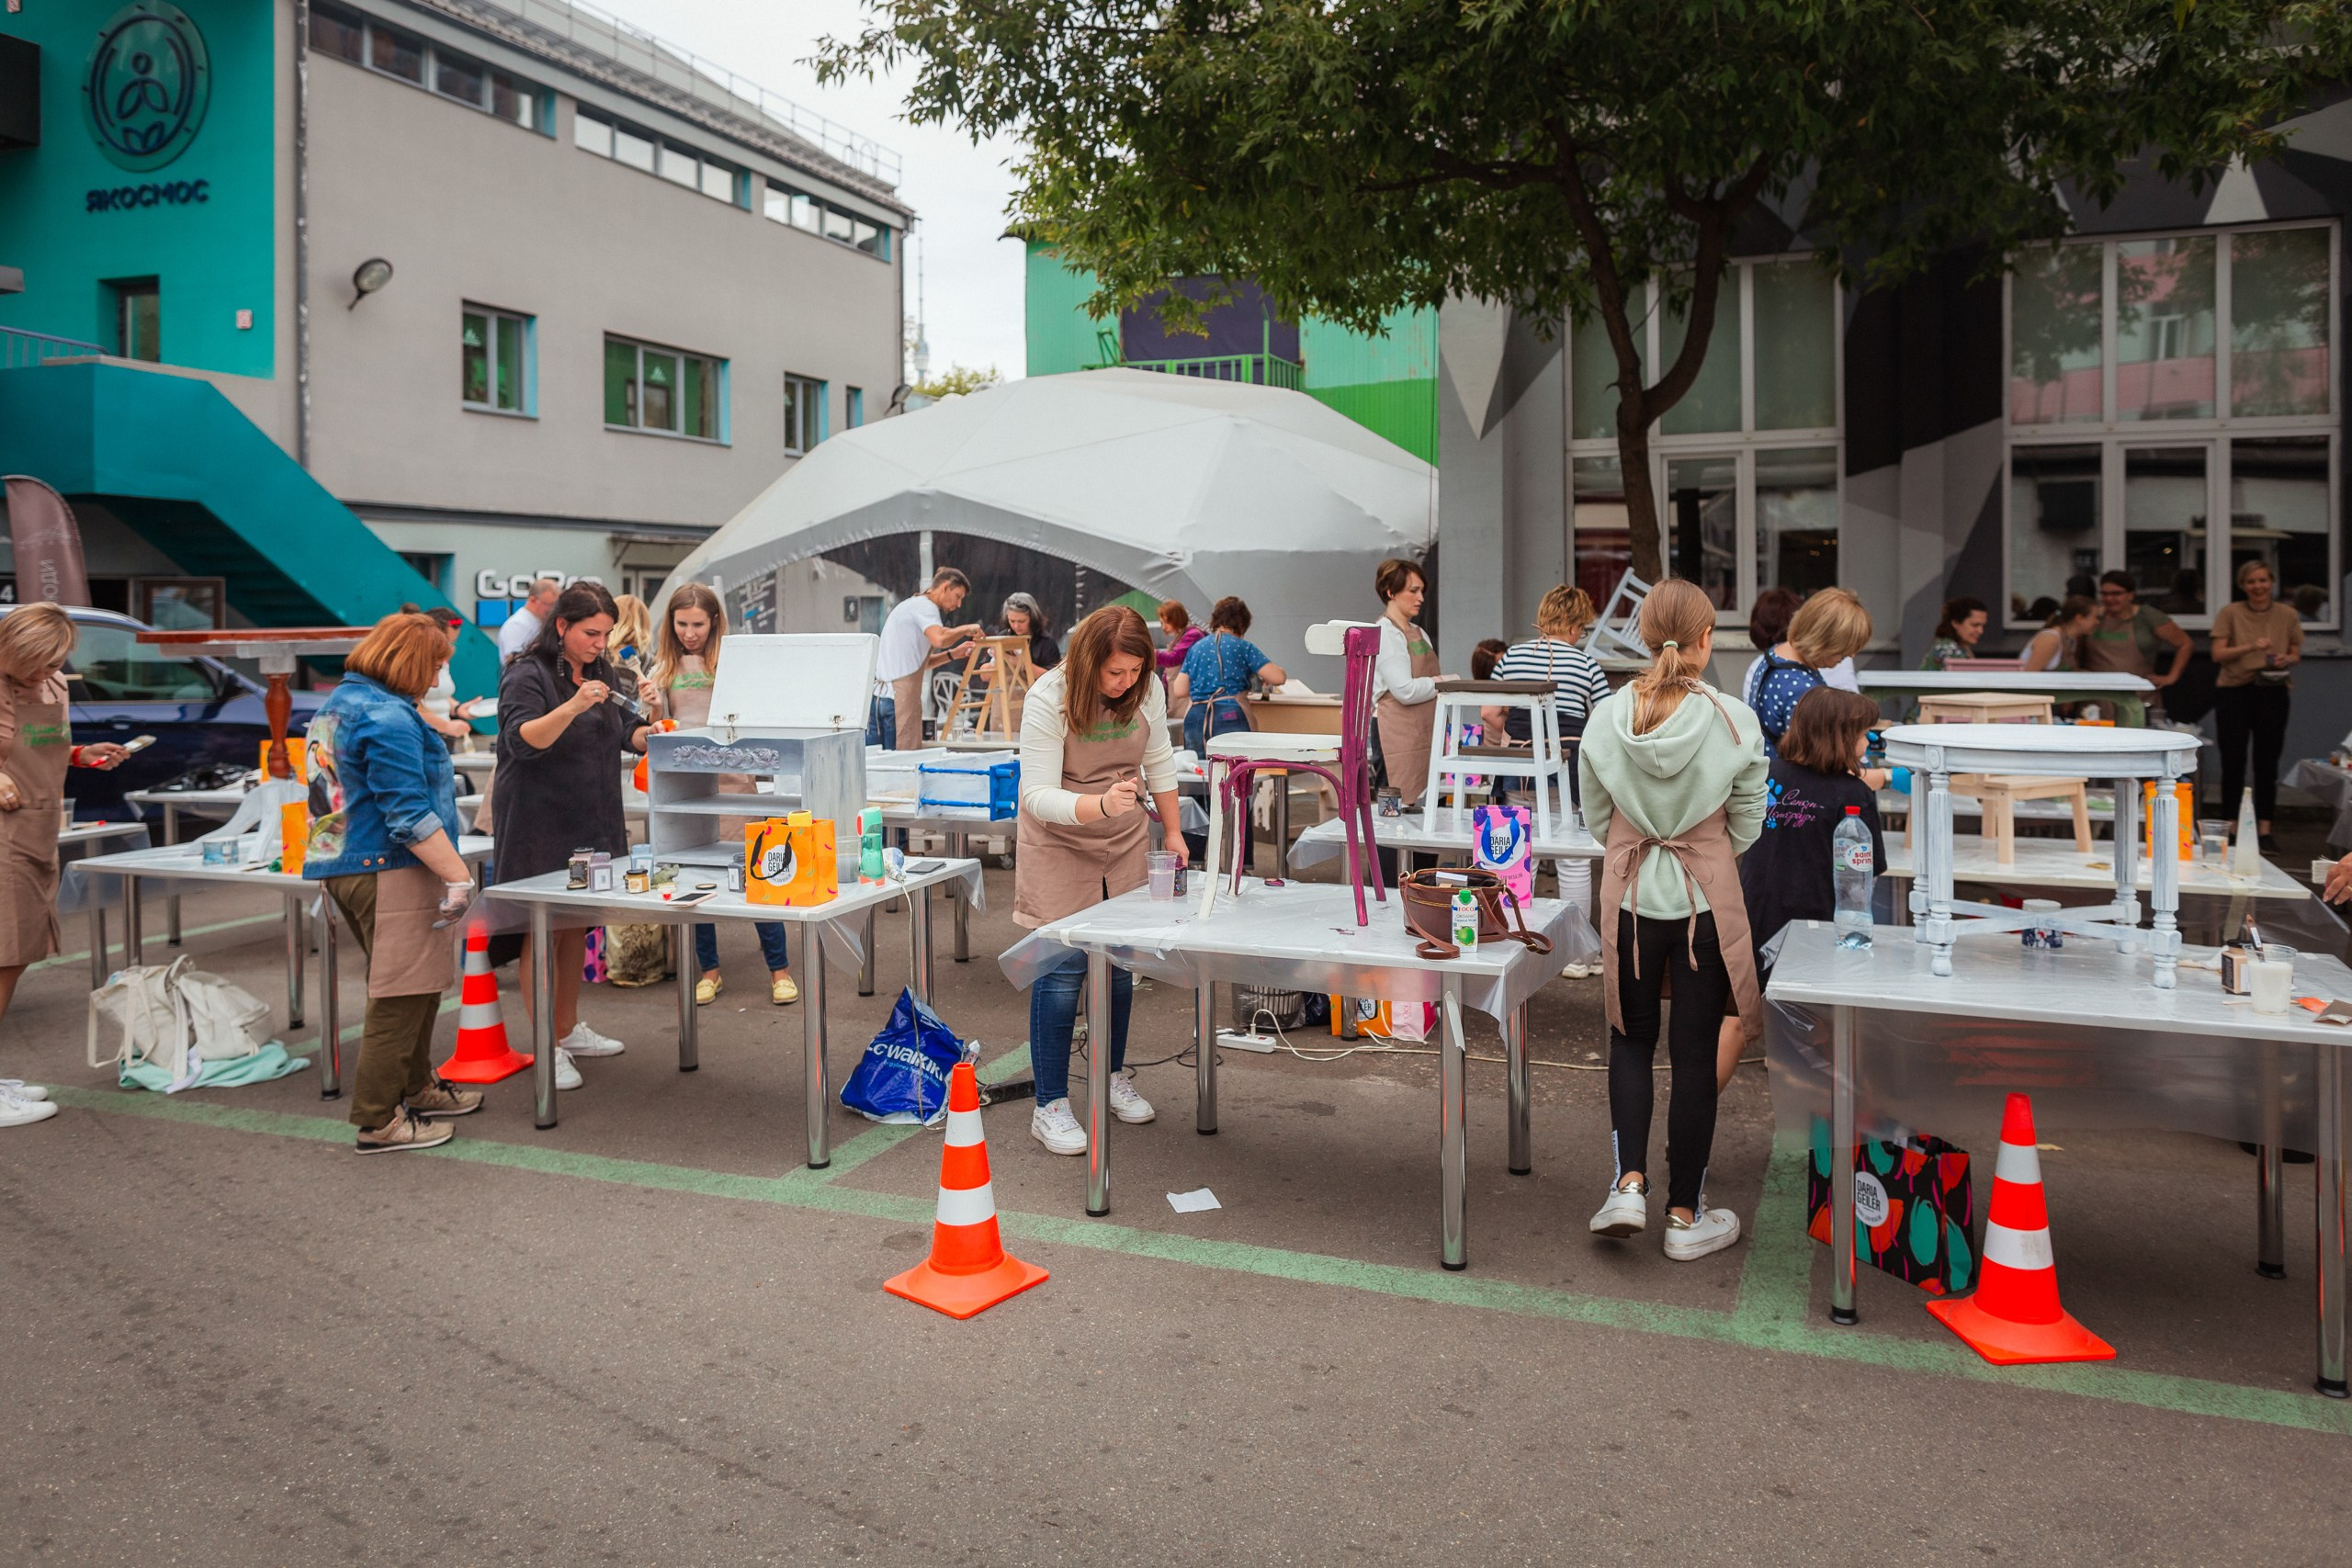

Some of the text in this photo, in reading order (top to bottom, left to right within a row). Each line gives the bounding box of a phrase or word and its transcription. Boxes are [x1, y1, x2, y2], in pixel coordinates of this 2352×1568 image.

[768, 852, 786, 862] DARI
[1857, 1179, 1878, 1198] DARIA
[1857, 1191, 1881, 1212] GEILER
